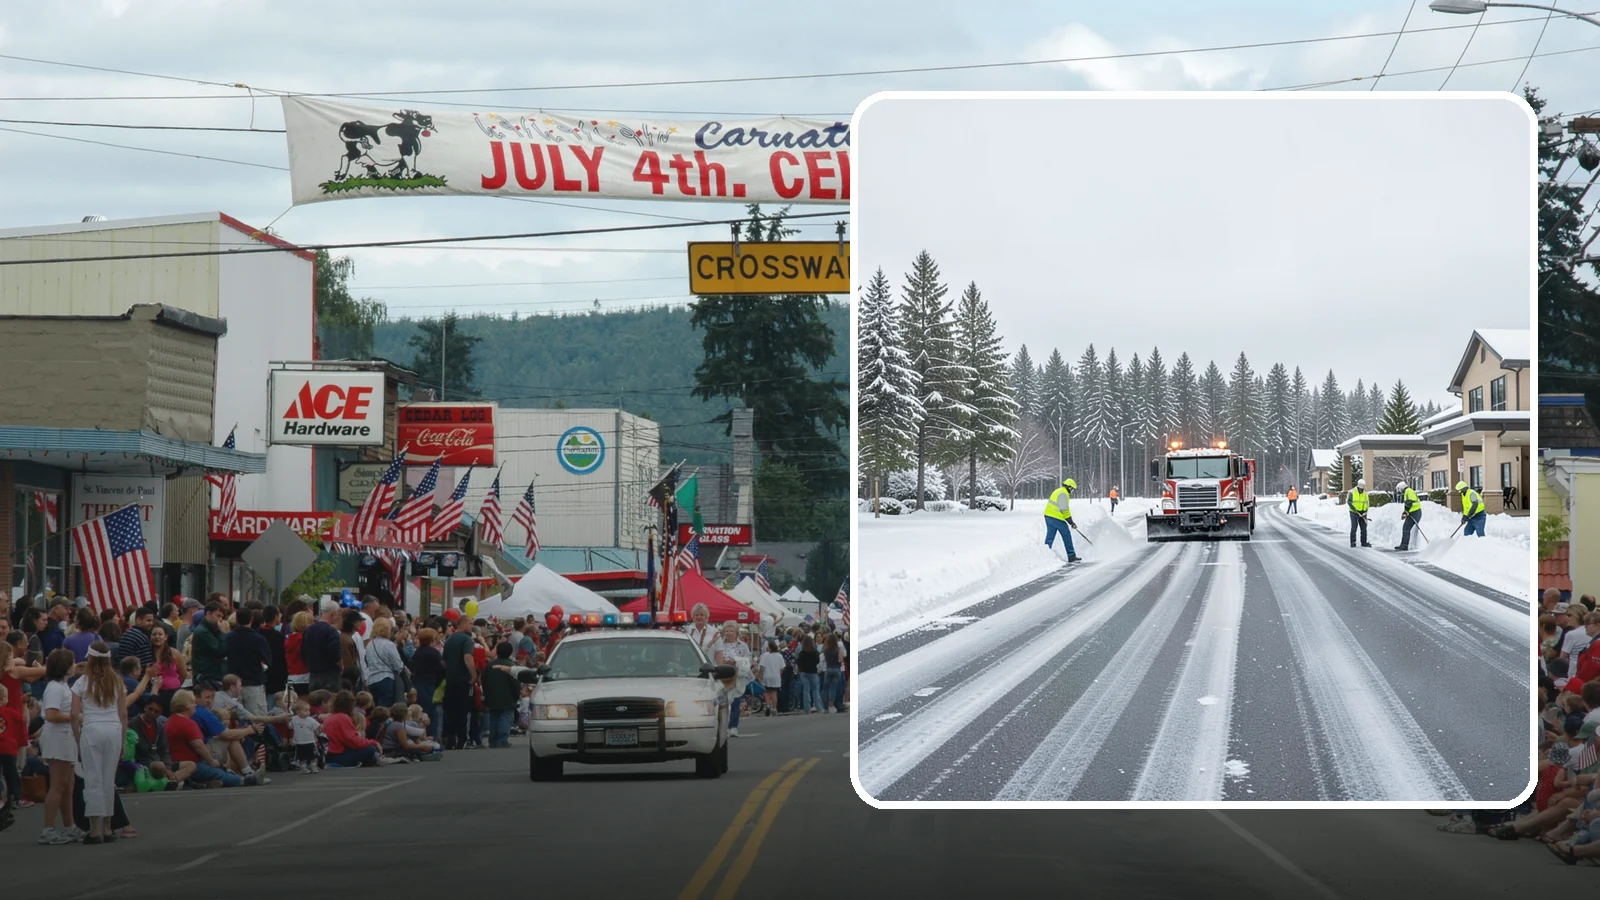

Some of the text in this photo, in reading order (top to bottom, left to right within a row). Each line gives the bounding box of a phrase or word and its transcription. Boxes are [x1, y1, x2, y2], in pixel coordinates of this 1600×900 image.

[481, 141, 605, 193] JULY
[633, 149, 746, 197] 4th.
[697, 254, 850, 280] CROSSWA
[282, 380, 374, 420] ACE
[405, 409, 485, 422] CEDAR LOG
[283, 421, 371, 437] Hardware
[353, 467, 386, 481] Simpl
[83, 485, 155, 495] St. Vincent de Paul
[688, 526, 741, 535] CRNATION
[699, 535, 730, 543] GLASS
